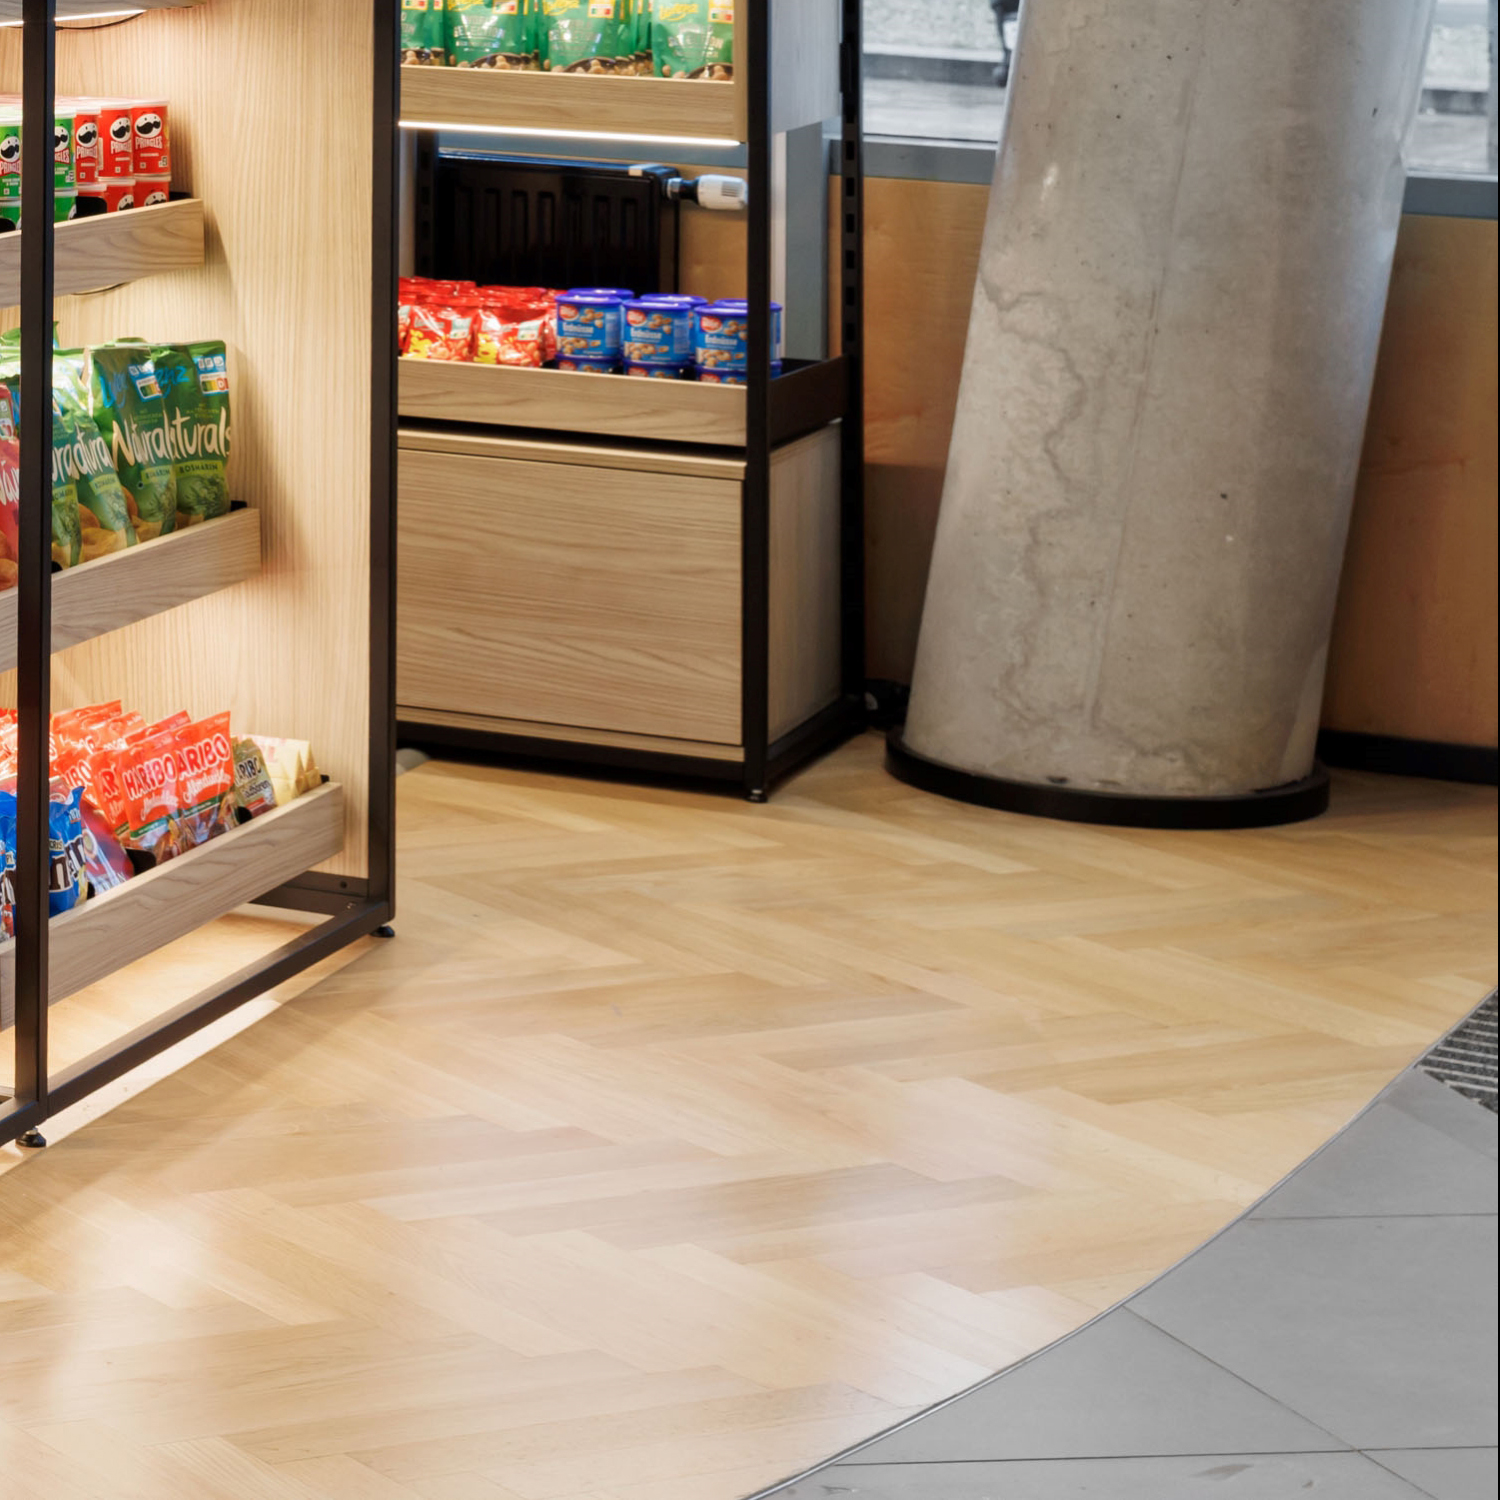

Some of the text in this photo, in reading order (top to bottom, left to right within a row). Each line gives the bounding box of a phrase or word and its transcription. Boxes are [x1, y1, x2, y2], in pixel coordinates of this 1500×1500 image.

[135, 136, 163, 149] PRINGLES
[179, 462, 219, 473] ROSMARIN
[122, 754, 177, 800] HARIBO
